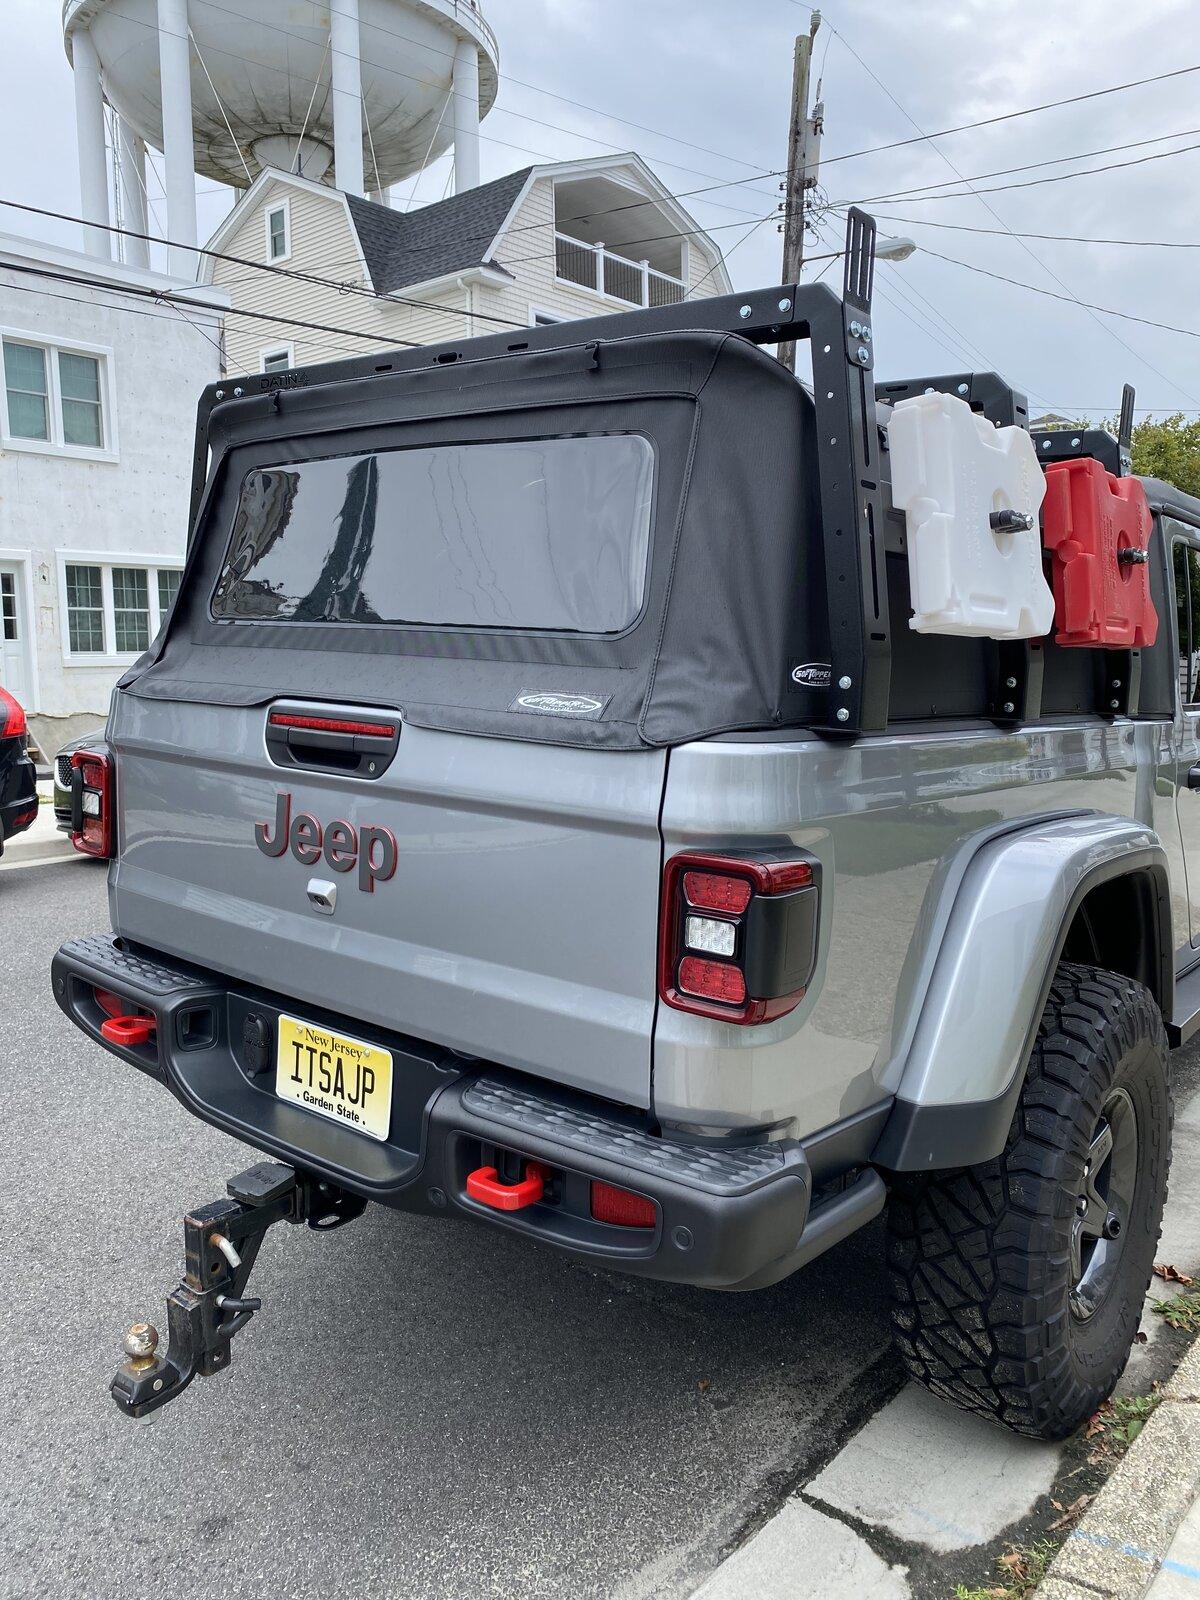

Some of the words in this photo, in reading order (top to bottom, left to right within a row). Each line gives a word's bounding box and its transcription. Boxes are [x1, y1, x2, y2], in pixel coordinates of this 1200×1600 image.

[254, 792, 399, 893] Jeep
[305, 1027, 329, 1047] New
[329, 1036, 363, 1062] Jersey
[290, 1040, 375, 1109] ITSAJP
[302, 1090, 334, 1112] Garden
[336, 1103, 360, 1123] State
